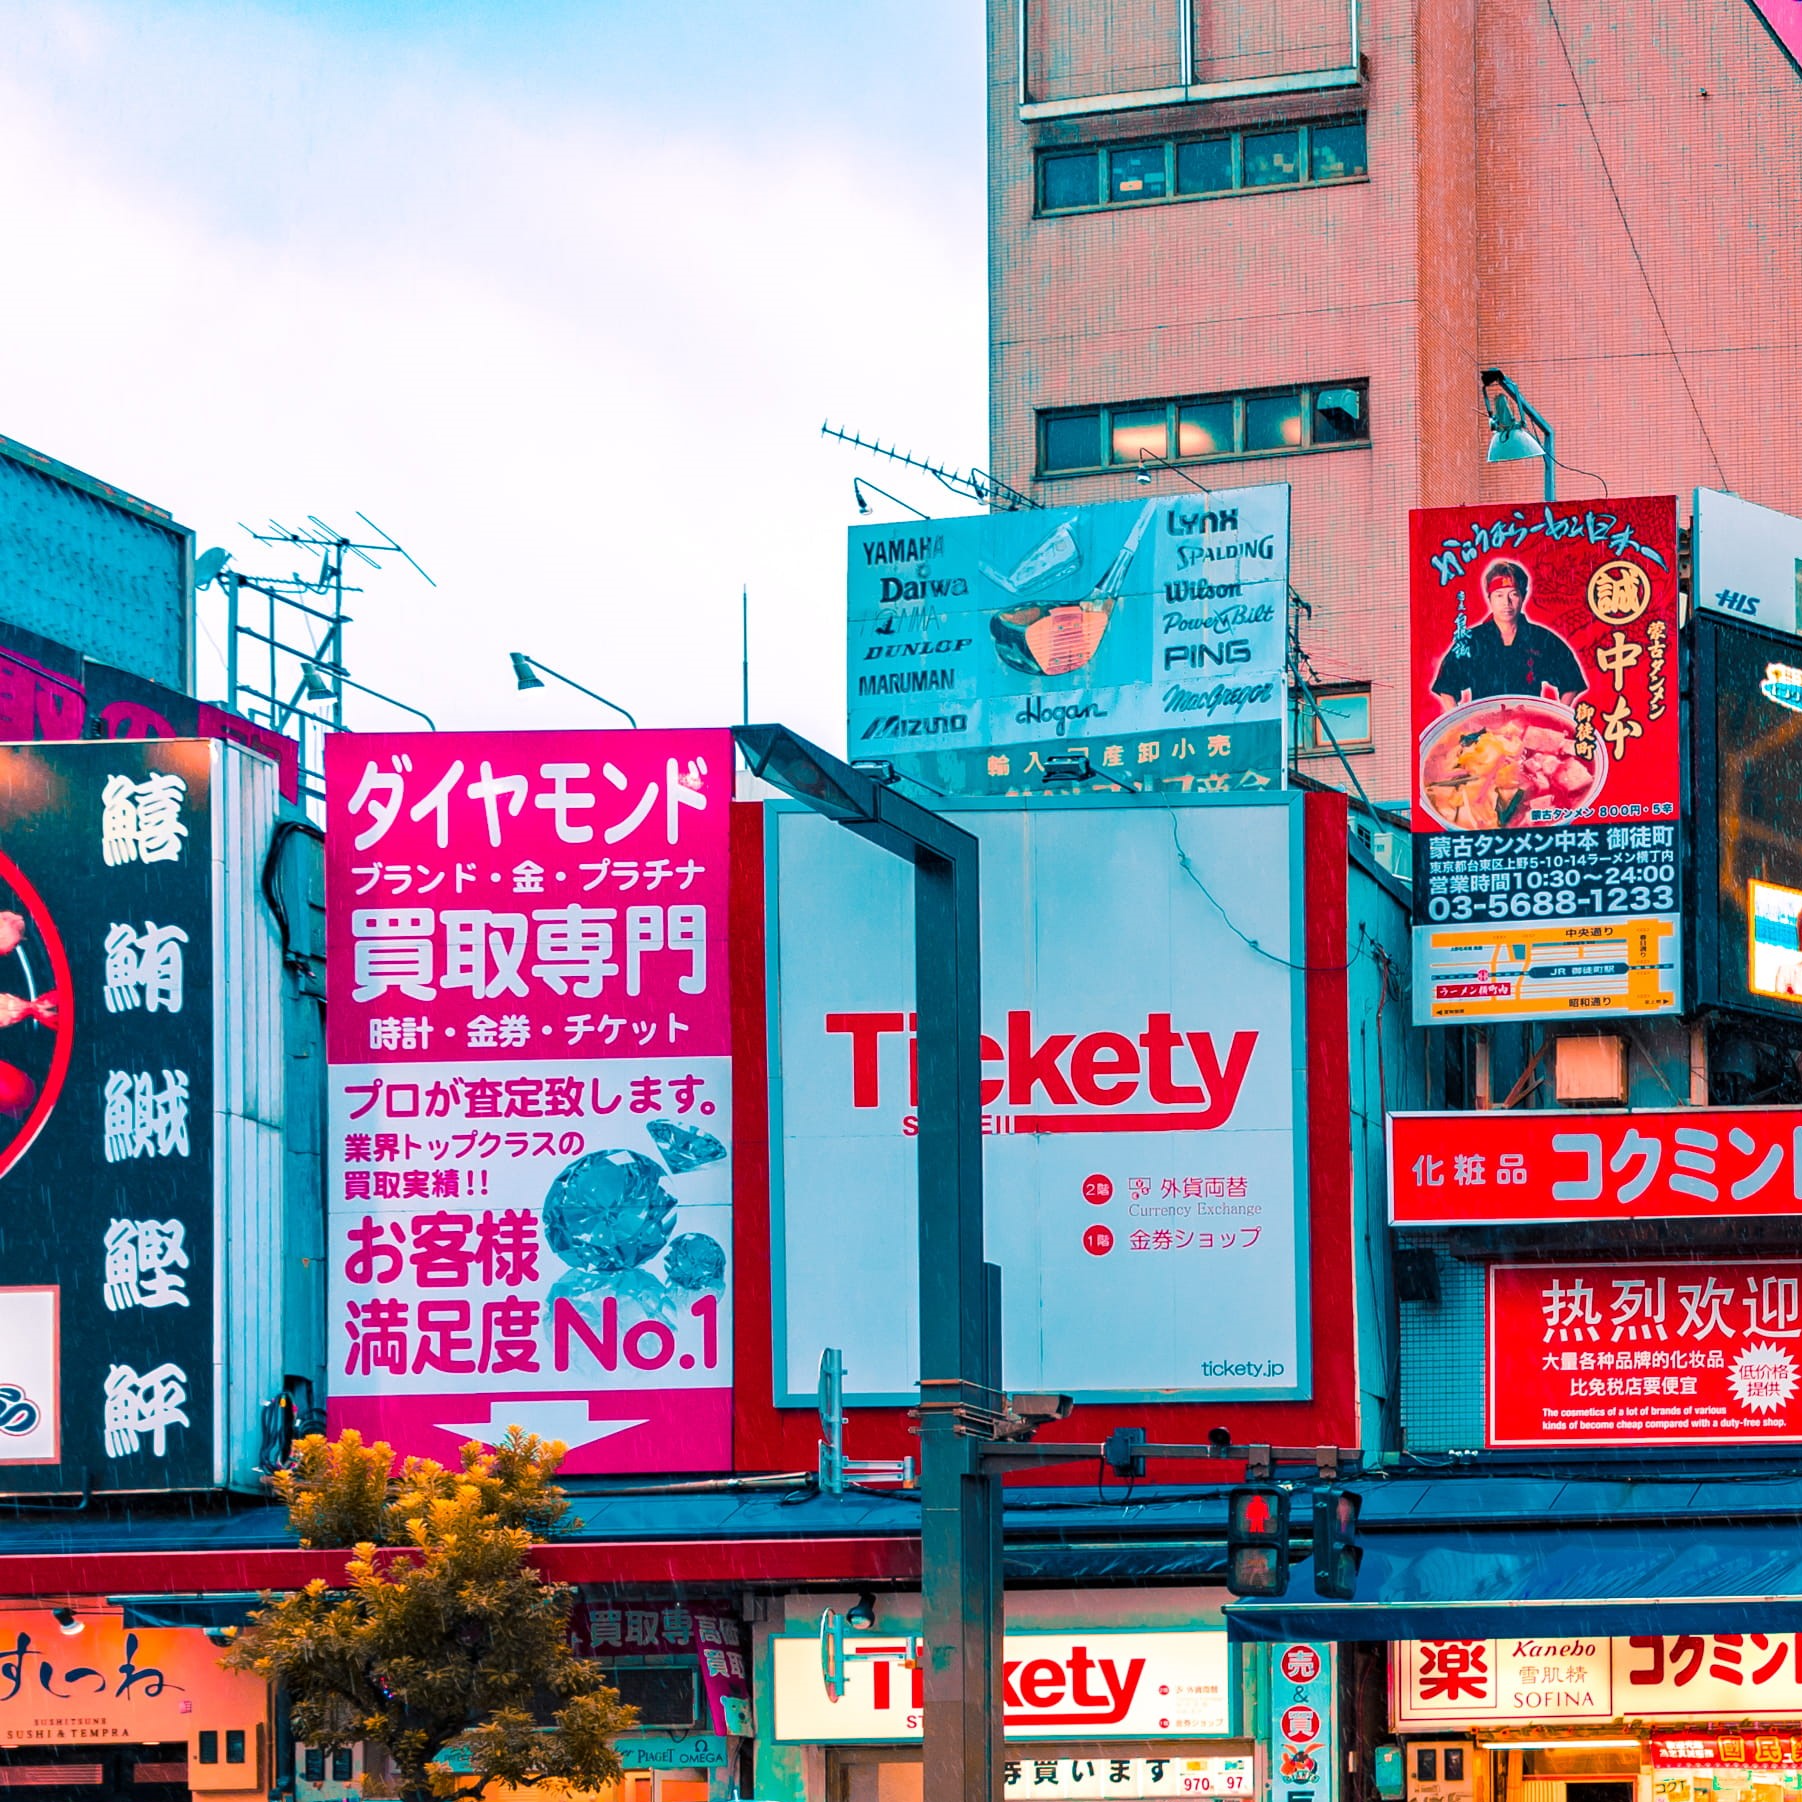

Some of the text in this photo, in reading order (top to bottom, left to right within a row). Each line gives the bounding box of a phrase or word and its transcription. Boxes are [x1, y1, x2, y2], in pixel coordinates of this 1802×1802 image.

[863, 535, 944, 566] YAMAHA
[1177, 535, 1274, 571] SPALDING
[881, 576, 968, 603] Daiwa
[1164, 579, 1242, 604] Wilson
[863, 639, 972, 661] DUNLOP
[1164, 639, 1251, 670] PING
[859, 669, 954, 696] MARUMAN
[1647, 621, 1666, 720] 蒙古タンメン
[1597, 632, 1642, 760] 中本
[1016, 696, 1108, 736] Hogan
[1575, 703, 1596, 760] 御徒町
[348, 755, 709, 852] ダイヤモンド
[1429, 826, 1674, 859] 蒙古タンメン中本 御徒町
[352, 860, 705, 897] ブランド・金・プラチナ
[1428, 886, 1674, 921] 03-5688-1233
[1565, 926, 1614, 938] 中央通り
[351, 904, 707, 1002] 買取専門
[1551, 967, 1566, 976] JR
[1569, 997, 1611, 1007] 昭和通り
[369, 1013, 689, 1049] 時計・金券・チケット
[344, 1075, 717, 1118] プロが査定致します。
[345, 1131, 583, 1160] 業界トップクラスの
[1411, 1152, 1528, 1188] 化粧品
[1086, 1176, 1248, 1199] 2階 外貨両替
[1128, 1201, 1262, 1218] Currency Exchange
[345, 1210, 539, 1287] お客様
[1128, 1226, 1262, 1250] 金券ショップ
[1542, 1276, 1802, 1343] 热烈欢迎
[1201, 1359, 1286, 1379] tickety.jp
[1542, 1350, 1725, 1371] 大量各种品牌的化妆品
[1739, 1363, 1789, 1380] 低价格
[1570, 1377, 1697, 1396] 比免税店要便宜
[1747, 1381, 1781, 1397] 提供
[1543, 1408, 1559, 1417] The
[1561, 1407, 1606, 1417] cosmetics
[1608, 1407, 1616, 1416] of
[1626, 1407, 1638, 1416] lot
[1640, 1407, 1649, 1416] of
[1651, 1406, 1681, 1415] brands
[1683, 1406, 1692, 1415] of
[1694, 1407, 1726, 1415] various
[1543, 1421, 1567, 1430] kinds
[1569, 1420, 1578, 1430] of
[1580, 1420, 1614, 1430] become
[1616, 1420, 1643, 1432] cheap
[1645, 1420, 1689, 1431] compared
[1691, 1419, 1711, 1428] with
[1720, 1418, 1761, 1430] duty-free
[1512, 1640, 1596, 1658] Kanebo
[1518, 1665, 1588, 1685] 雪肌精
[1513, 1691, 1595, 1708] SOFINA
[7, 1730, 52, 1739] SUSHI
[72, 1729, 129, 1737] TEMPRA
[637, 1748, 724, 1763] PIAGET OMEGA
[1184, 1778, 1209, 1791] 970
